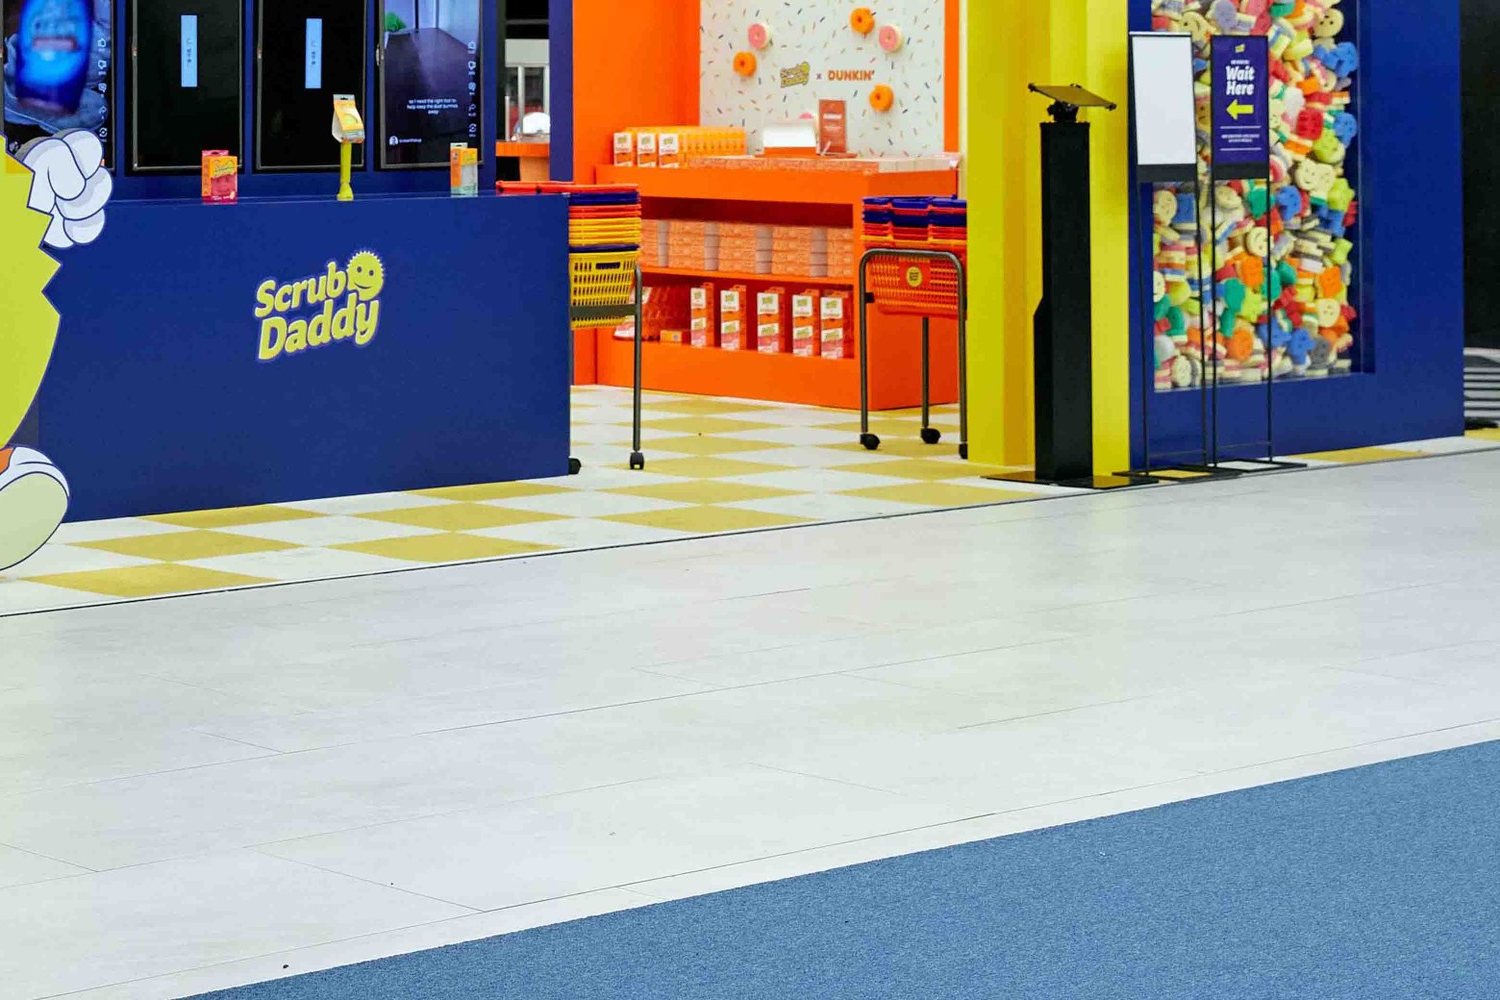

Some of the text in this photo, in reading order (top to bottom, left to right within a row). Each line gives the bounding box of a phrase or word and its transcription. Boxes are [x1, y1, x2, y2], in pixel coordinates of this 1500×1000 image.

[1225, 65, 1255, 81] Wait
[1225, 81, 1255, 96] Here
[254, 261, 347, 318] Scrub
[258, 292, 380, 360] Daddy
